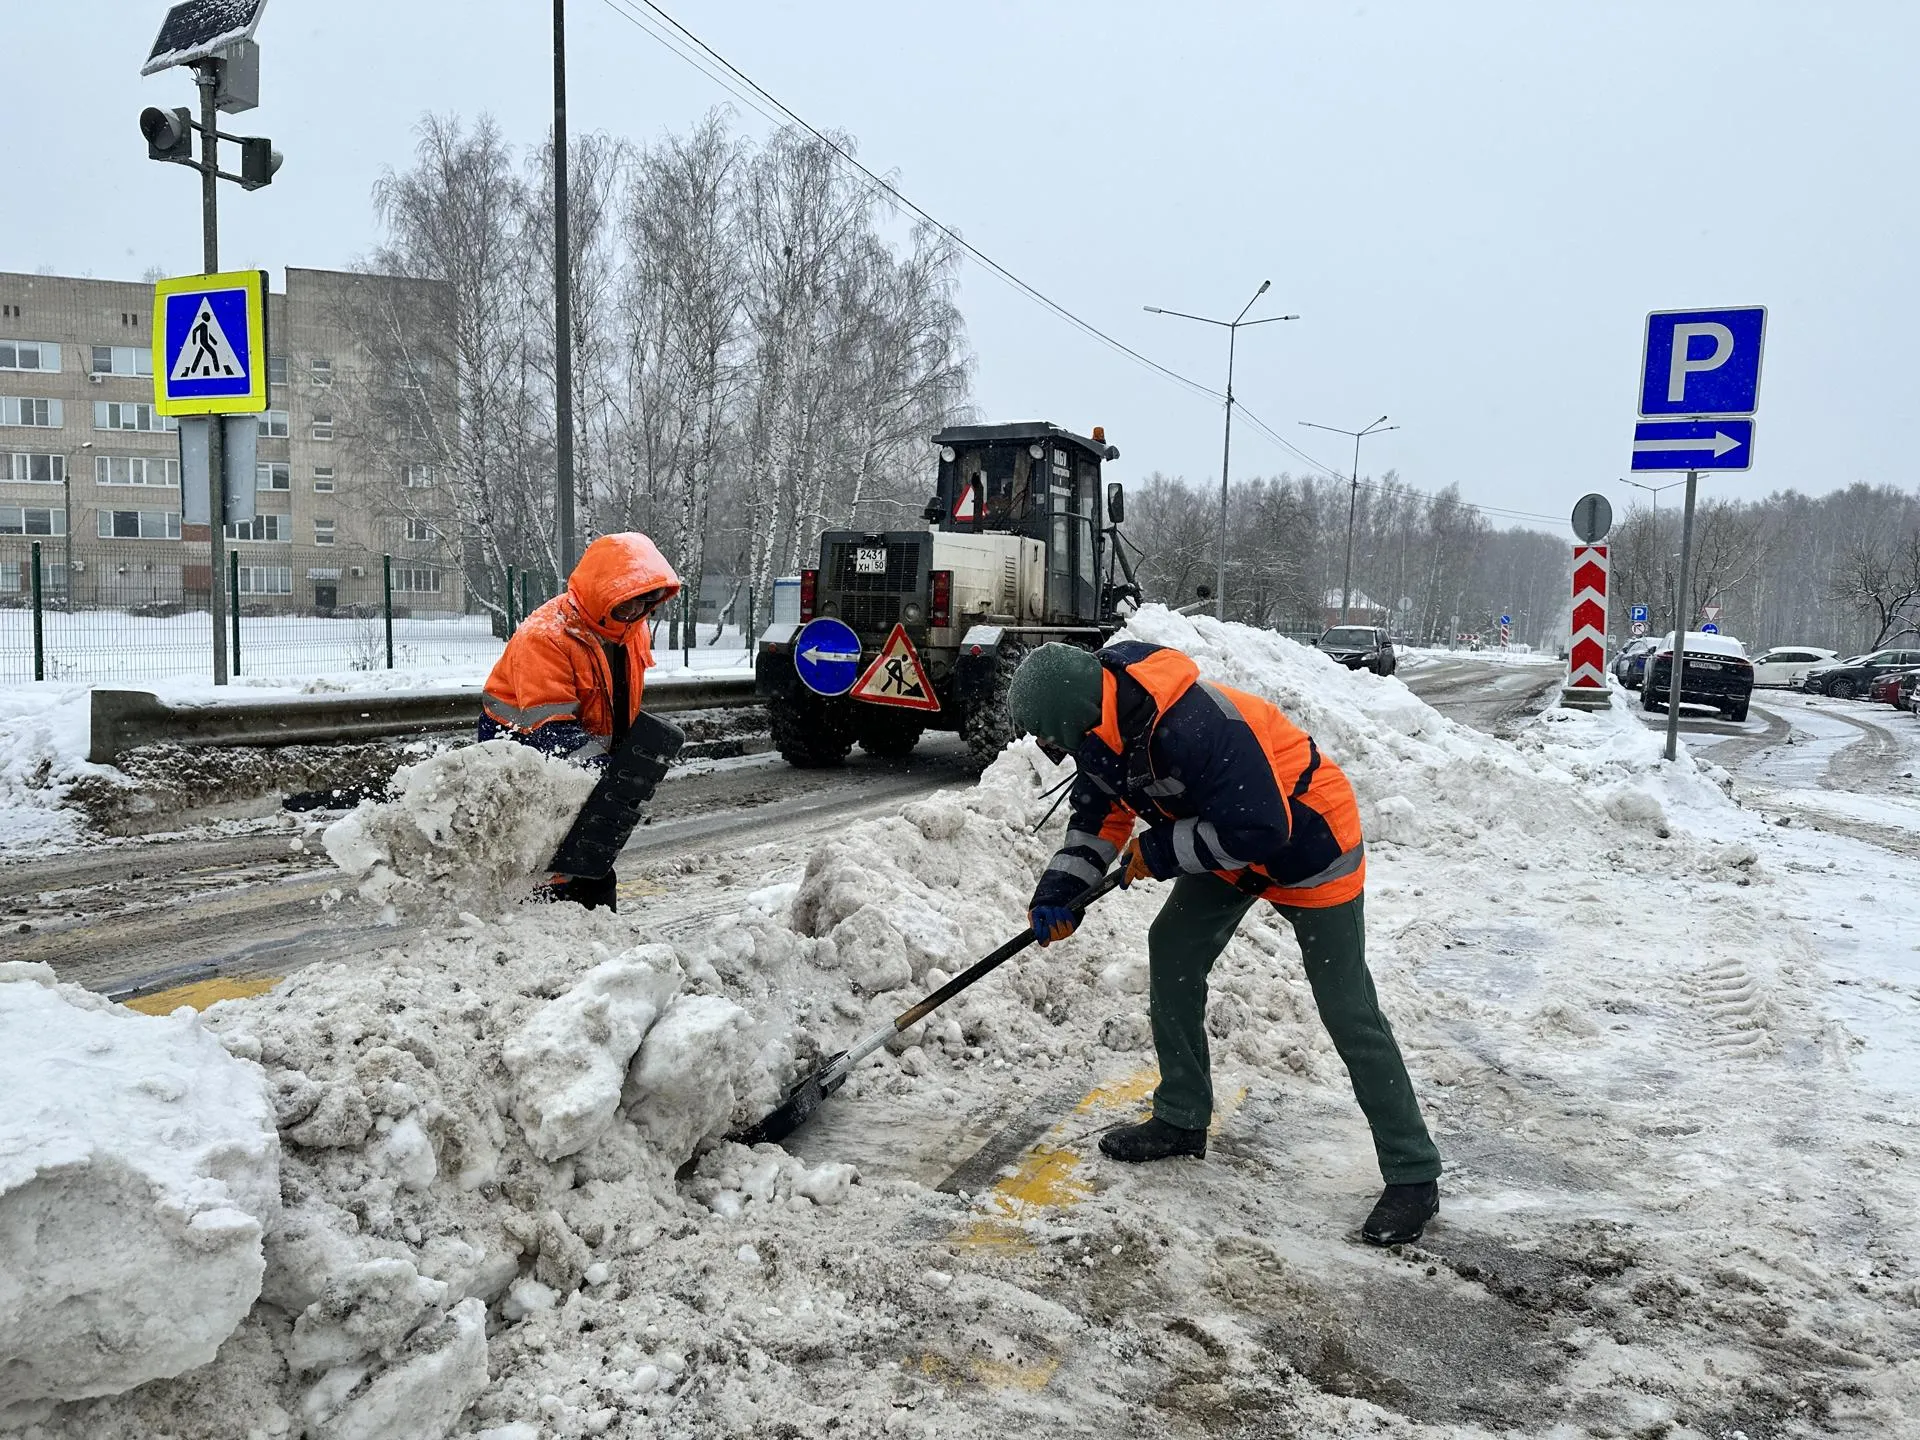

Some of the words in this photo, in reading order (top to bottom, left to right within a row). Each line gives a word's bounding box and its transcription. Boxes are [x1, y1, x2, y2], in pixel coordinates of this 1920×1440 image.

[1668, 322, 1734, 402] P
[860, 550, 883, 560] 2431
[874, 561, 884, 570] 50
[1634, 608, 1644, 620] P
